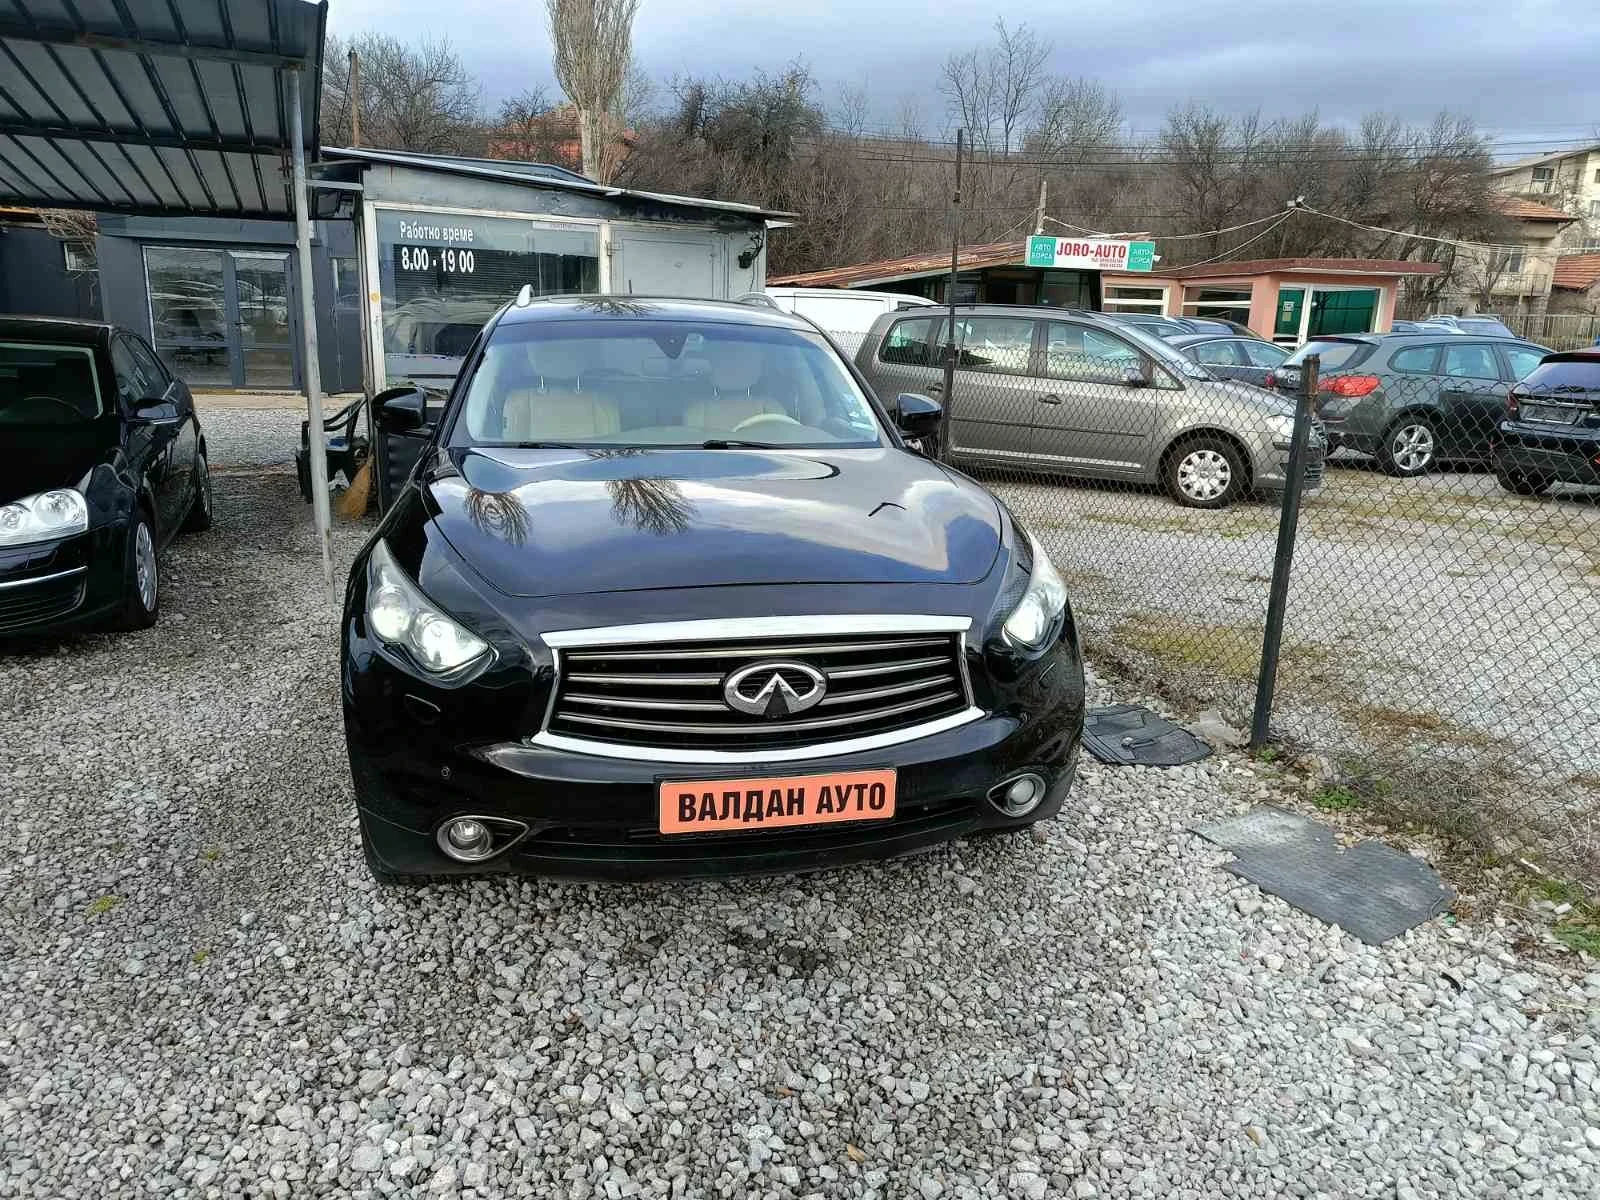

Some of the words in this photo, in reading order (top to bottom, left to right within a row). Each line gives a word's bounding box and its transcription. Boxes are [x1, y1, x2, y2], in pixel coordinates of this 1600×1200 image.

[400, 220, 440, 240] Работно
[443, 227, 473, 246] време
[401, 246, 429, 271] 8.00
[1056, 242, 1127, 258] JORO-AUTO
[678, 787, 805, 823] ВАЛДАН
[816, 782, 886, 815] АУТО
